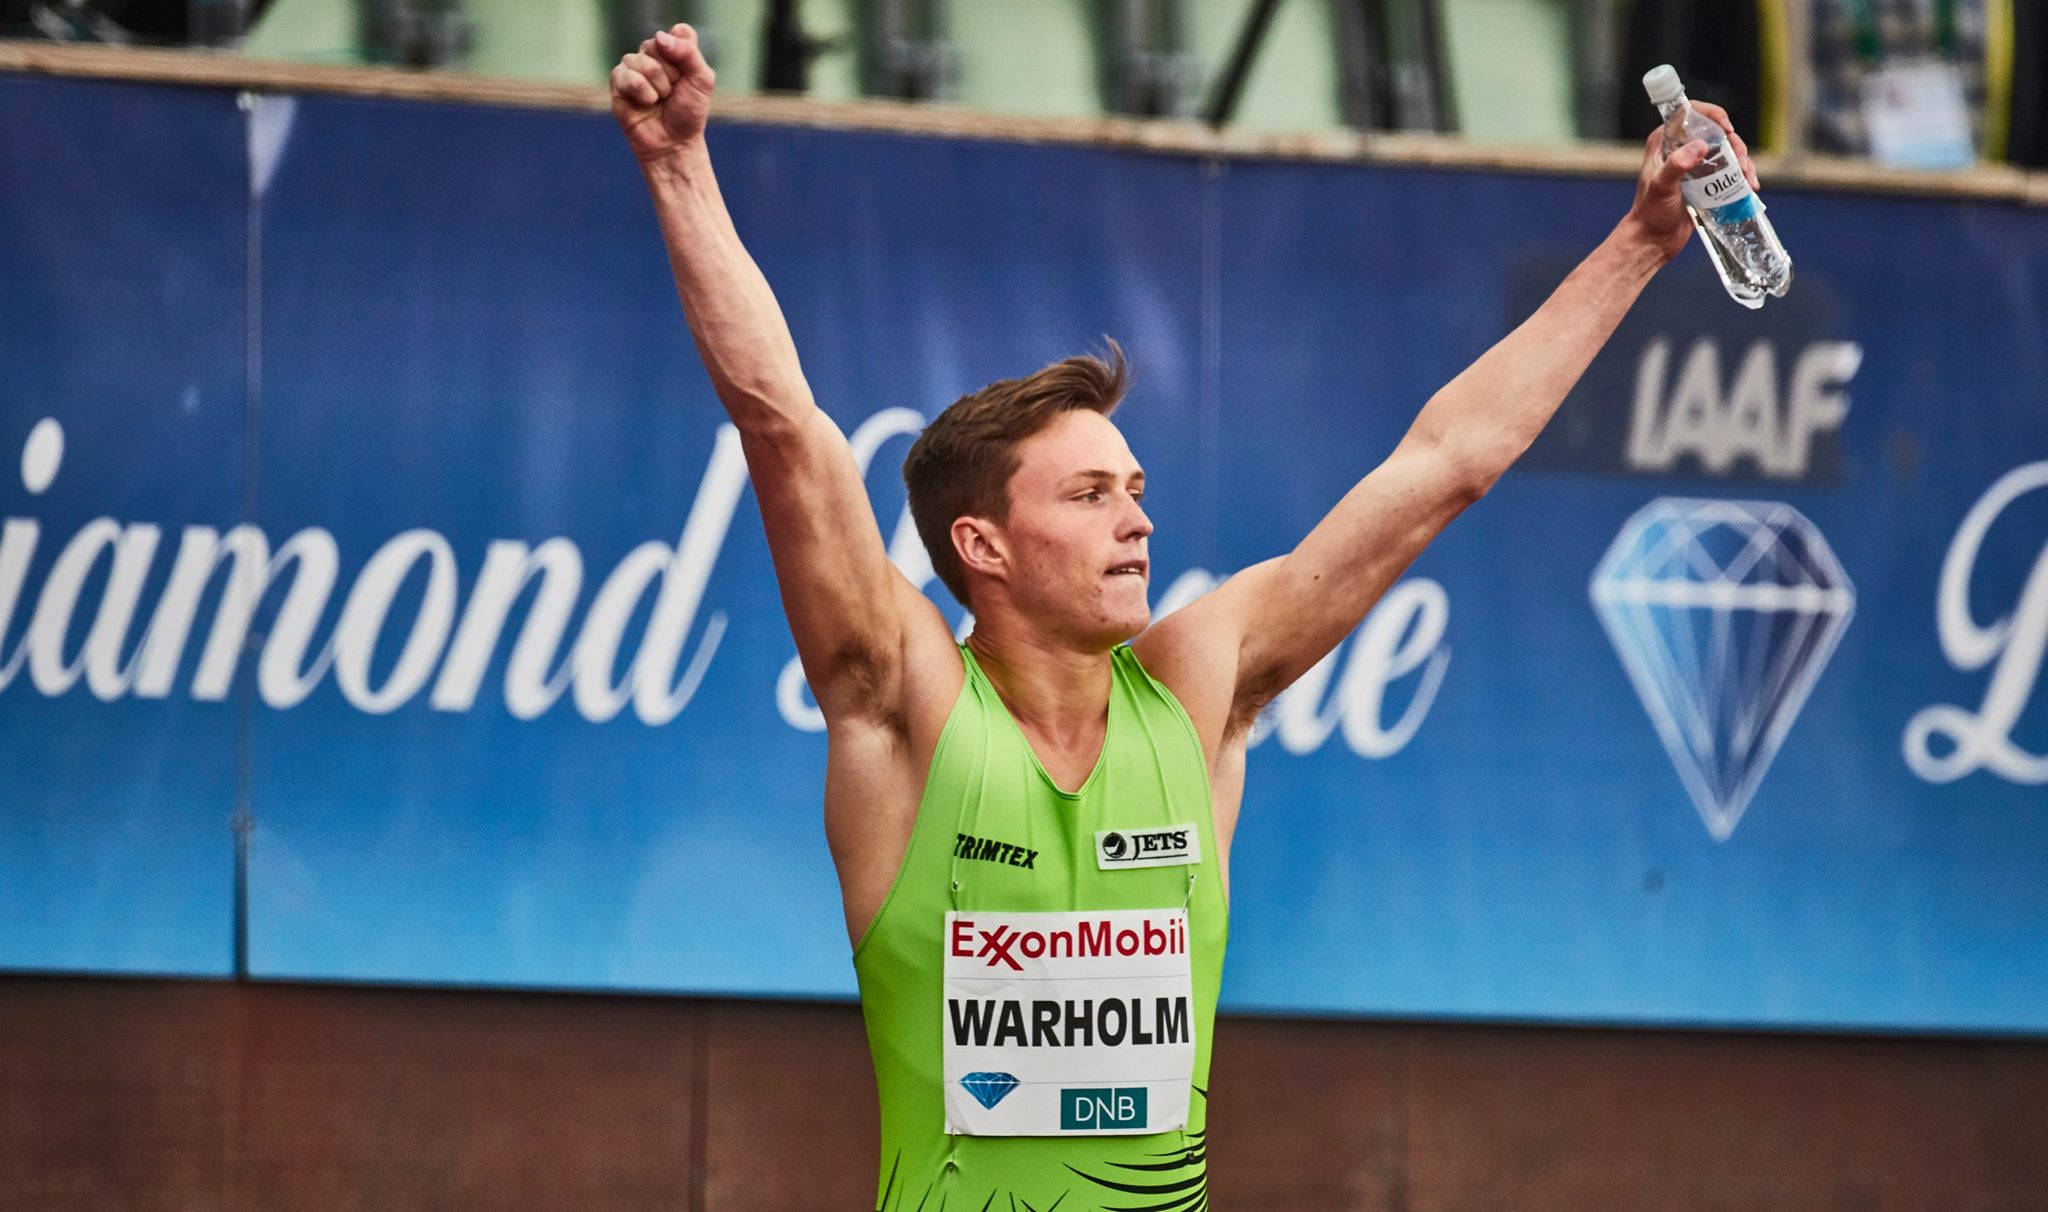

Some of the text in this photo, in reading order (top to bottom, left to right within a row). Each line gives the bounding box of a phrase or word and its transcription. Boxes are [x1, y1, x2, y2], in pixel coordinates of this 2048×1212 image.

[1703, 170, 1741, 197] Olde
[1626, 334, 1863, 478] IAAF
[0, 416, 748, 726] iamond
[953, 833, 1039, 870] TRIMTEX
[1131, 831, 1188, 861] JETS
[951, 918, 1185, 971] ExxonMobil
[948, 996, 1190, 1047] WARHOLM
[1075, 1088, 1136, 1130] DNB
